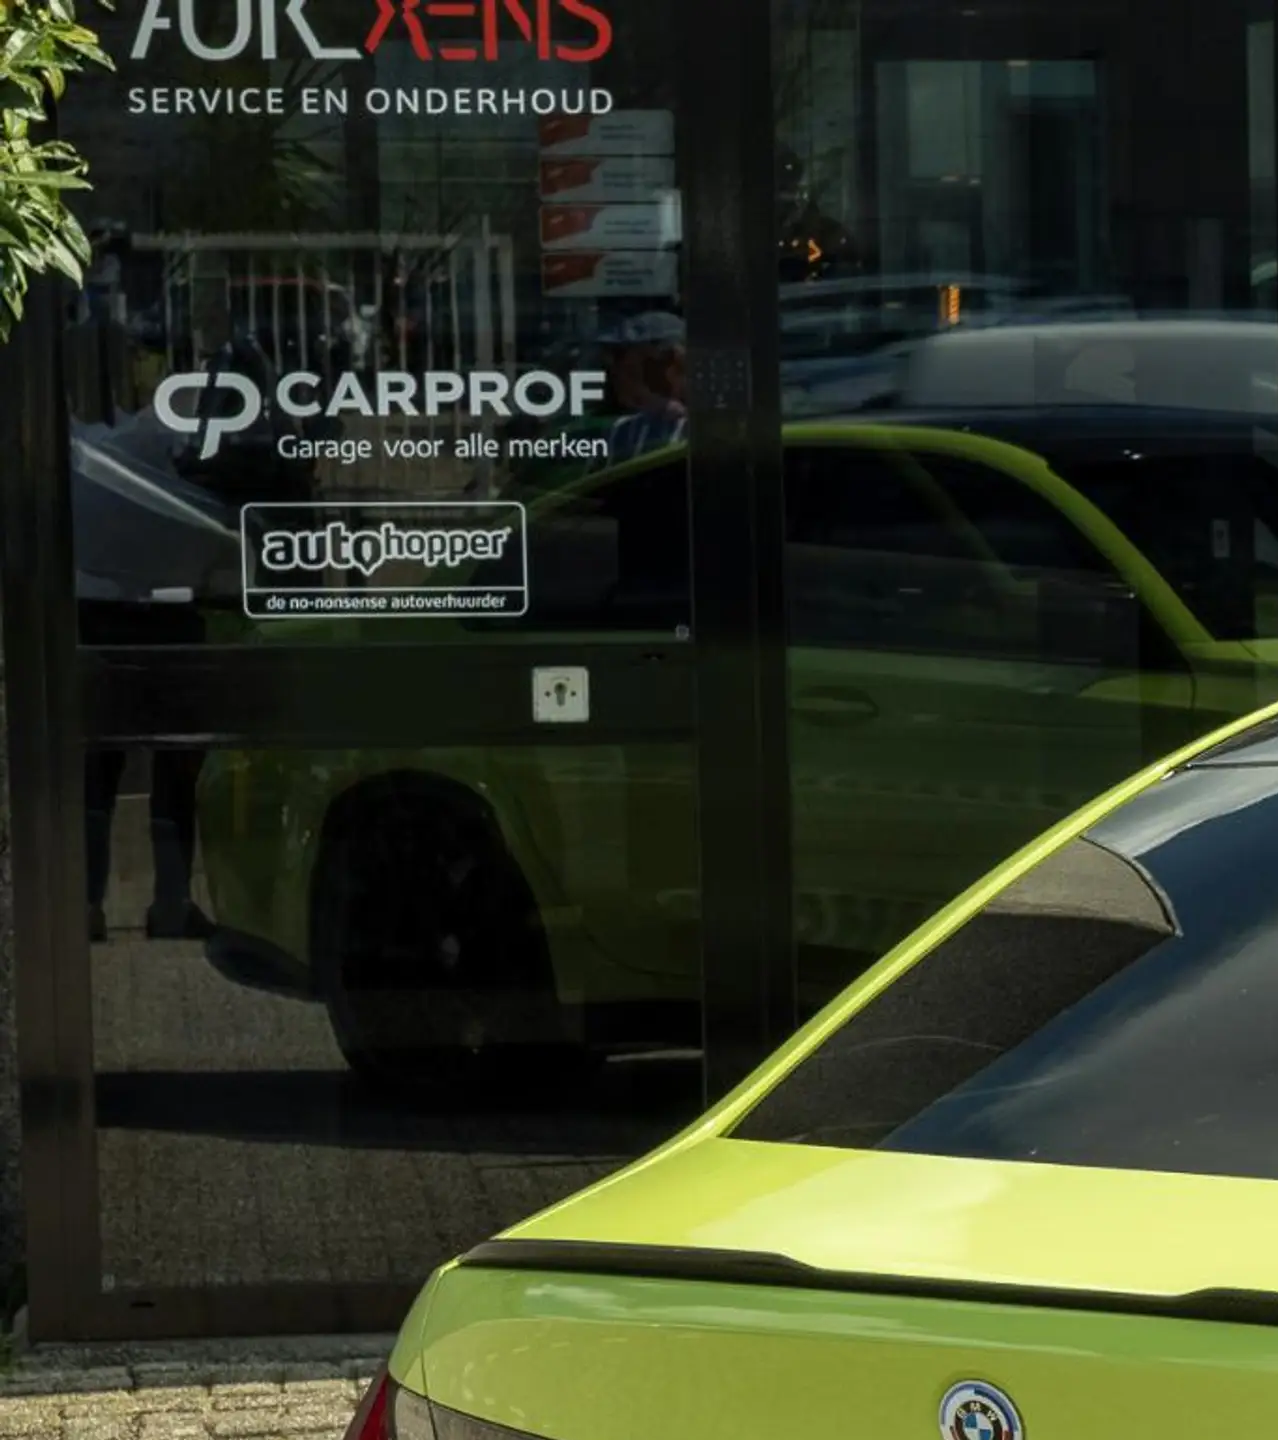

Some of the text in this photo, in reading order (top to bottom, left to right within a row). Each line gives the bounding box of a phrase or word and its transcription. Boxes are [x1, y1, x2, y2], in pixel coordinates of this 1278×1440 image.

[129, 87, 613, 114] SERVICE EN ONDERHOUD
[276, 370, 606, 416] CARPROF
[277, 433, 608, 463] Garage voor alle merken
[261, 521, 511, 576] autohopper
[266, 593, 506, 610] de no-nonsense autoverhuurder
[956, 1402, 998, 1421] BMW
